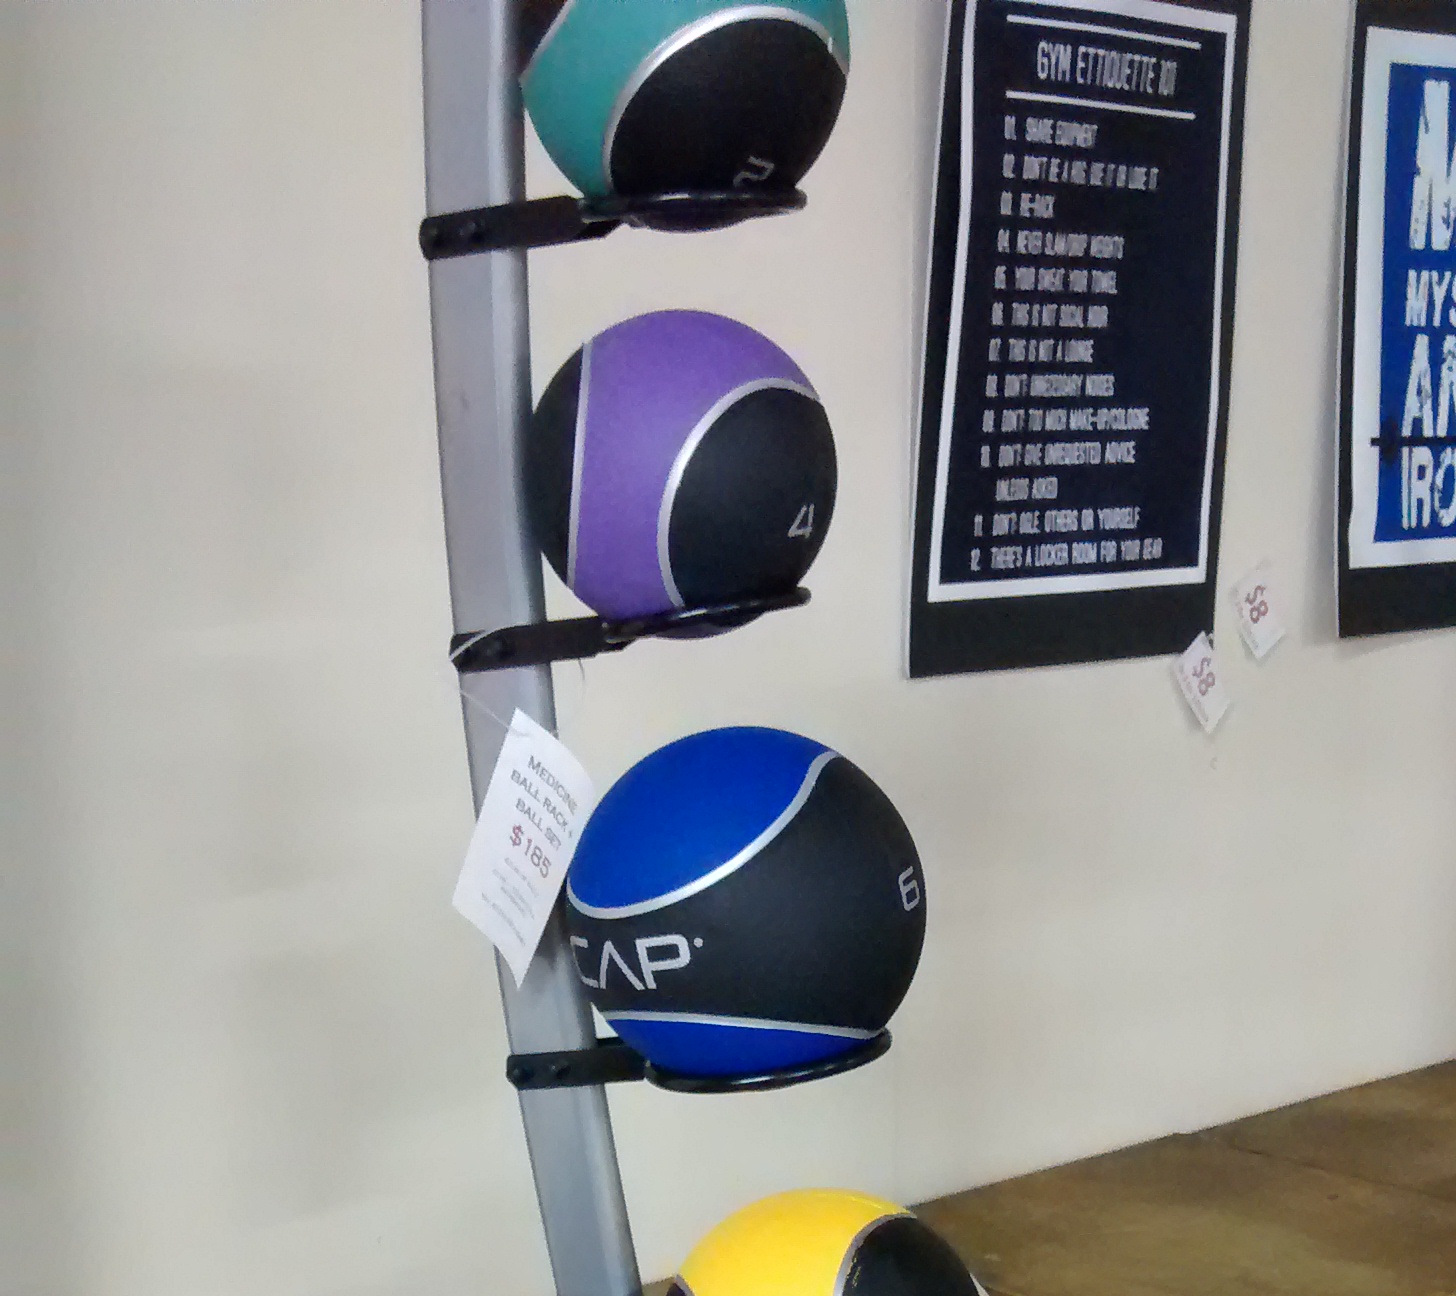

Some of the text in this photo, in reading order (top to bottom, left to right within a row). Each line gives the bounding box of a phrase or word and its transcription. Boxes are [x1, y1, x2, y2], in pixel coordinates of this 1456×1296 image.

[1037, 39, 1072, 82] GYM
[733, 156, 775, 188] 2
[787, 503, 815, 539] 4
[1025, 546, 1032, 567] A
[1035, 542, 1069, 567] LOCKER
[1072, 541, 1097, 565] ROOM
[1100, 540, 1117, 563] FOR
[1120, 539, 1141, 562] YOUR
[1245, 585, 1268, 624] $8
[1192, 656, 1215, 696] $8
[510, 768, 541, 803] BALL
[543, 797, 568, 832] RACK
[528, 755, 578, 816] MEDICINE
[515, 798, 543, 833] BALL
[510, 824, 552, 879] $185
[898, 865, 921, 912] 6
